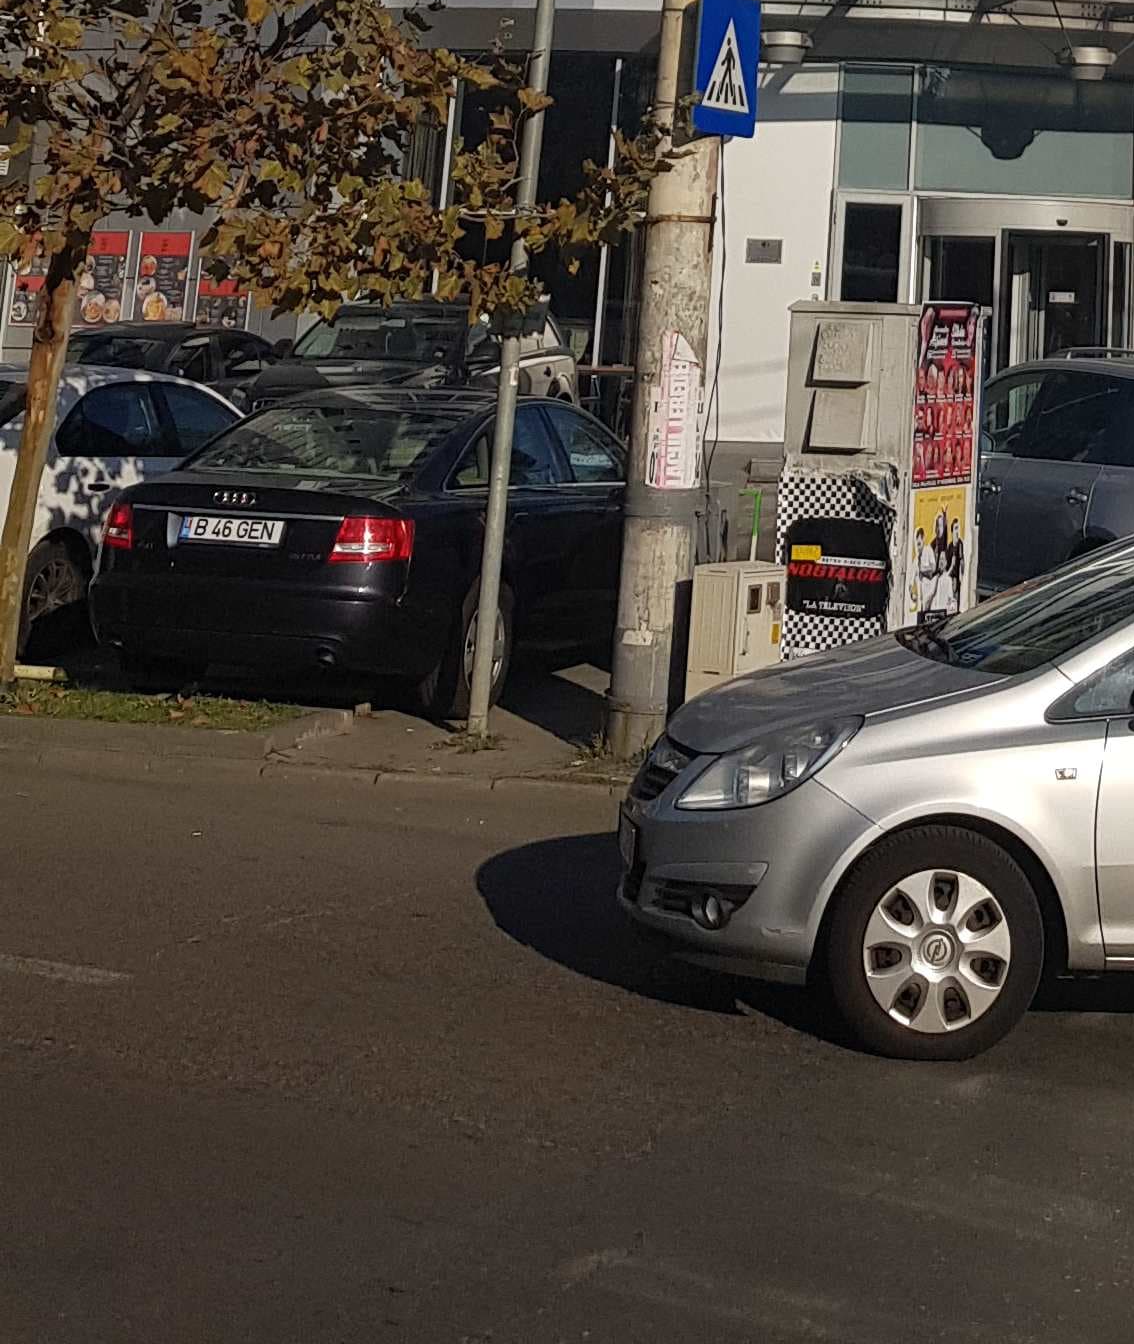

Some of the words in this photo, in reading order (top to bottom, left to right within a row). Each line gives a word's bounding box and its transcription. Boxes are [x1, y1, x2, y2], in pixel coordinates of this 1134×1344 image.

[194, 518, 208, 536] B
[211, 519, 232, 538] 46
[236, 520, 276, 541] GEN
